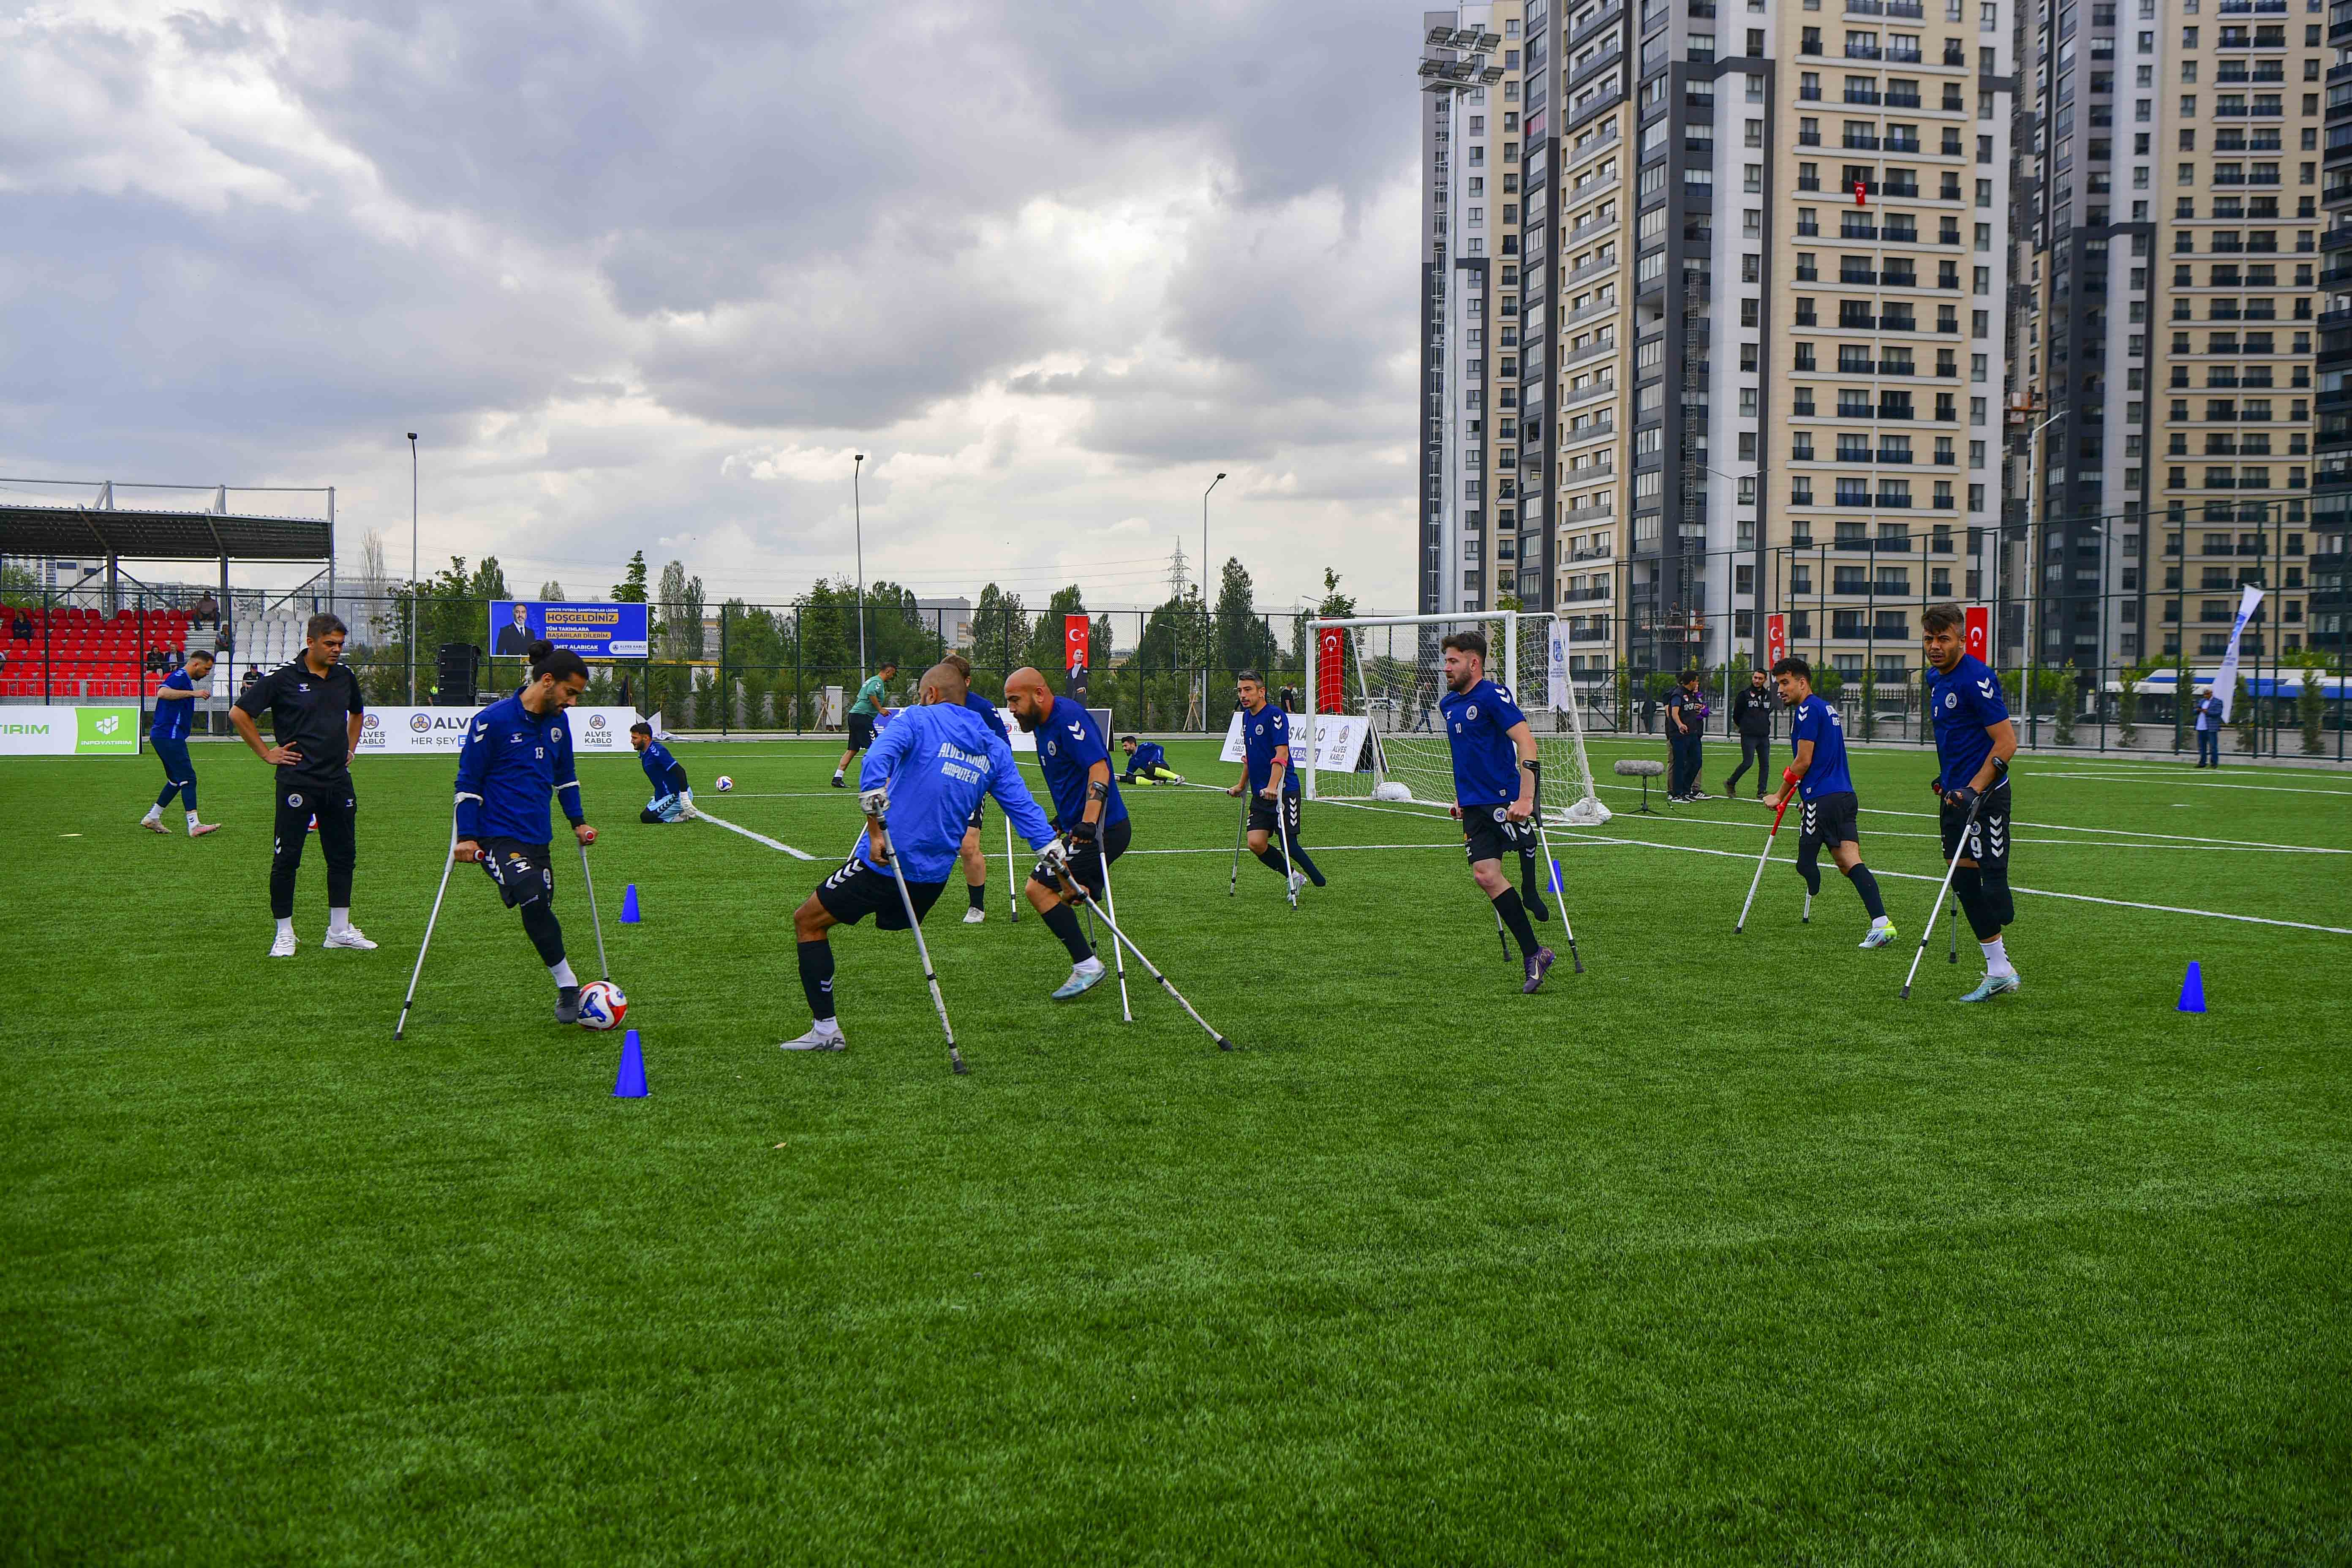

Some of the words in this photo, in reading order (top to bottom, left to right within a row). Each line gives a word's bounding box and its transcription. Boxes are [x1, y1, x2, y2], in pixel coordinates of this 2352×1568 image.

[547, 612, 617, 623] HOŞGELDİNİZ.
[1934, 706, 1938, 717] 9
[433, 717, 473, 729] ALV
[1455, 723, 1462, 733] 10
[0, 724, 49, 734] IRIM
[436, 737, 456, 746] ŞEY
[535, 747, 544, 759] 13
[1971, 836, 1983, 858] 9
